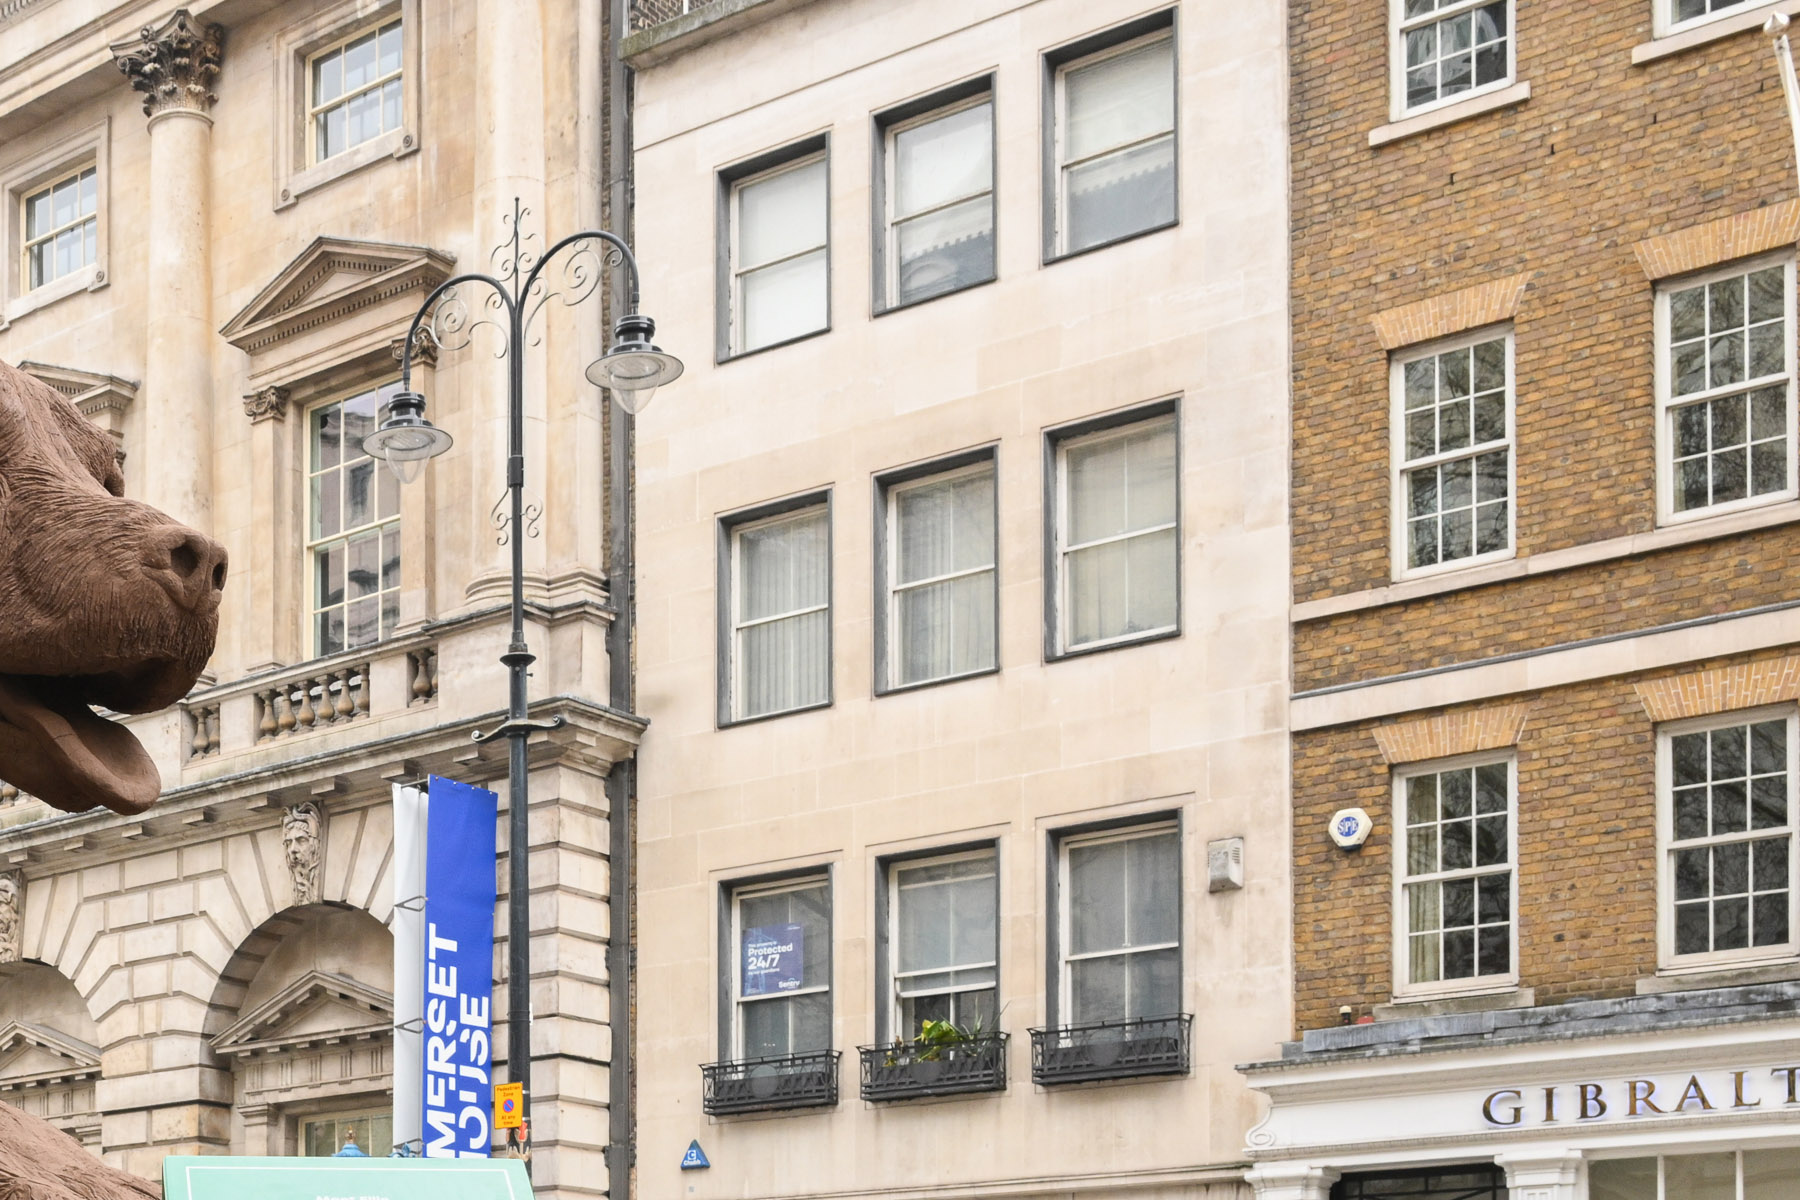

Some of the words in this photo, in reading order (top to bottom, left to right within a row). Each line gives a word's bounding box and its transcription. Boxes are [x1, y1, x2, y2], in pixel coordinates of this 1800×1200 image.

[748, 942, 793, 956] Protected
[748, 954, 780, 970] 24/7
[426, 922, 458, 1158] MERSET
[458, 993, 489, 1158] OUSE
[1482, 1066, 1800, 1125] GIBRALT
